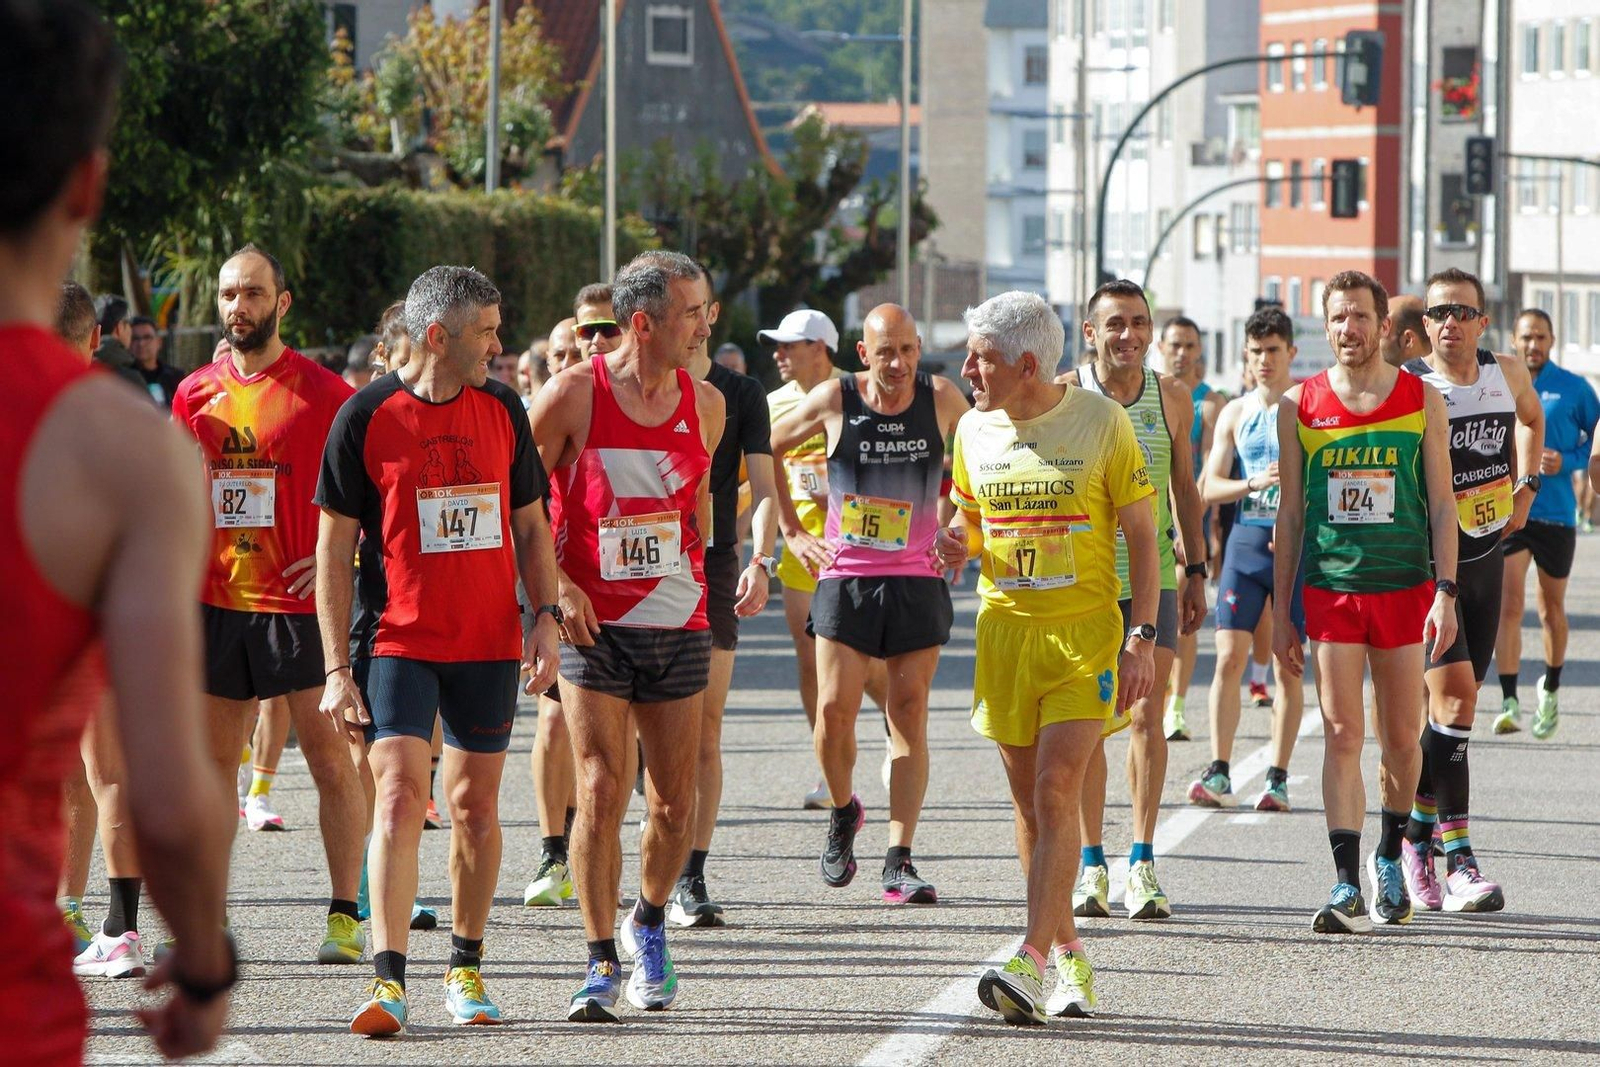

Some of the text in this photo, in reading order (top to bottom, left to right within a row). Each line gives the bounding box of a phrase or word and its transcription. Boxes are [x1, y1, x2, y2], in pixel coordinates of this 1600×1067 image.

[420, 434, 474, 449] CASTRELOS
[860, 439, 927, 452] O BARCO
[1038, 457, 1084, 467] San Lázaro
[1321, 446, 1399, 467] BIKILA
[800, 473, 817, 490] 90
[977, 479, 1075, 498] ATHLETICS
[222, 488, 247, 514] 82
[448, 499, 469, 507] DAVID
[989, 497, 1058, 512] San Lázaro
[1341, 488, 1374, 512] 124
[440, 506, 478, 538] 147
[1475, 499, 1496, 526] 55
[631, 528, 648, 536] LUIS
[862, 514, 880, 538] 15
[620, 535, 660, 567] 146
[1016, 548, 1036, 577] 17
